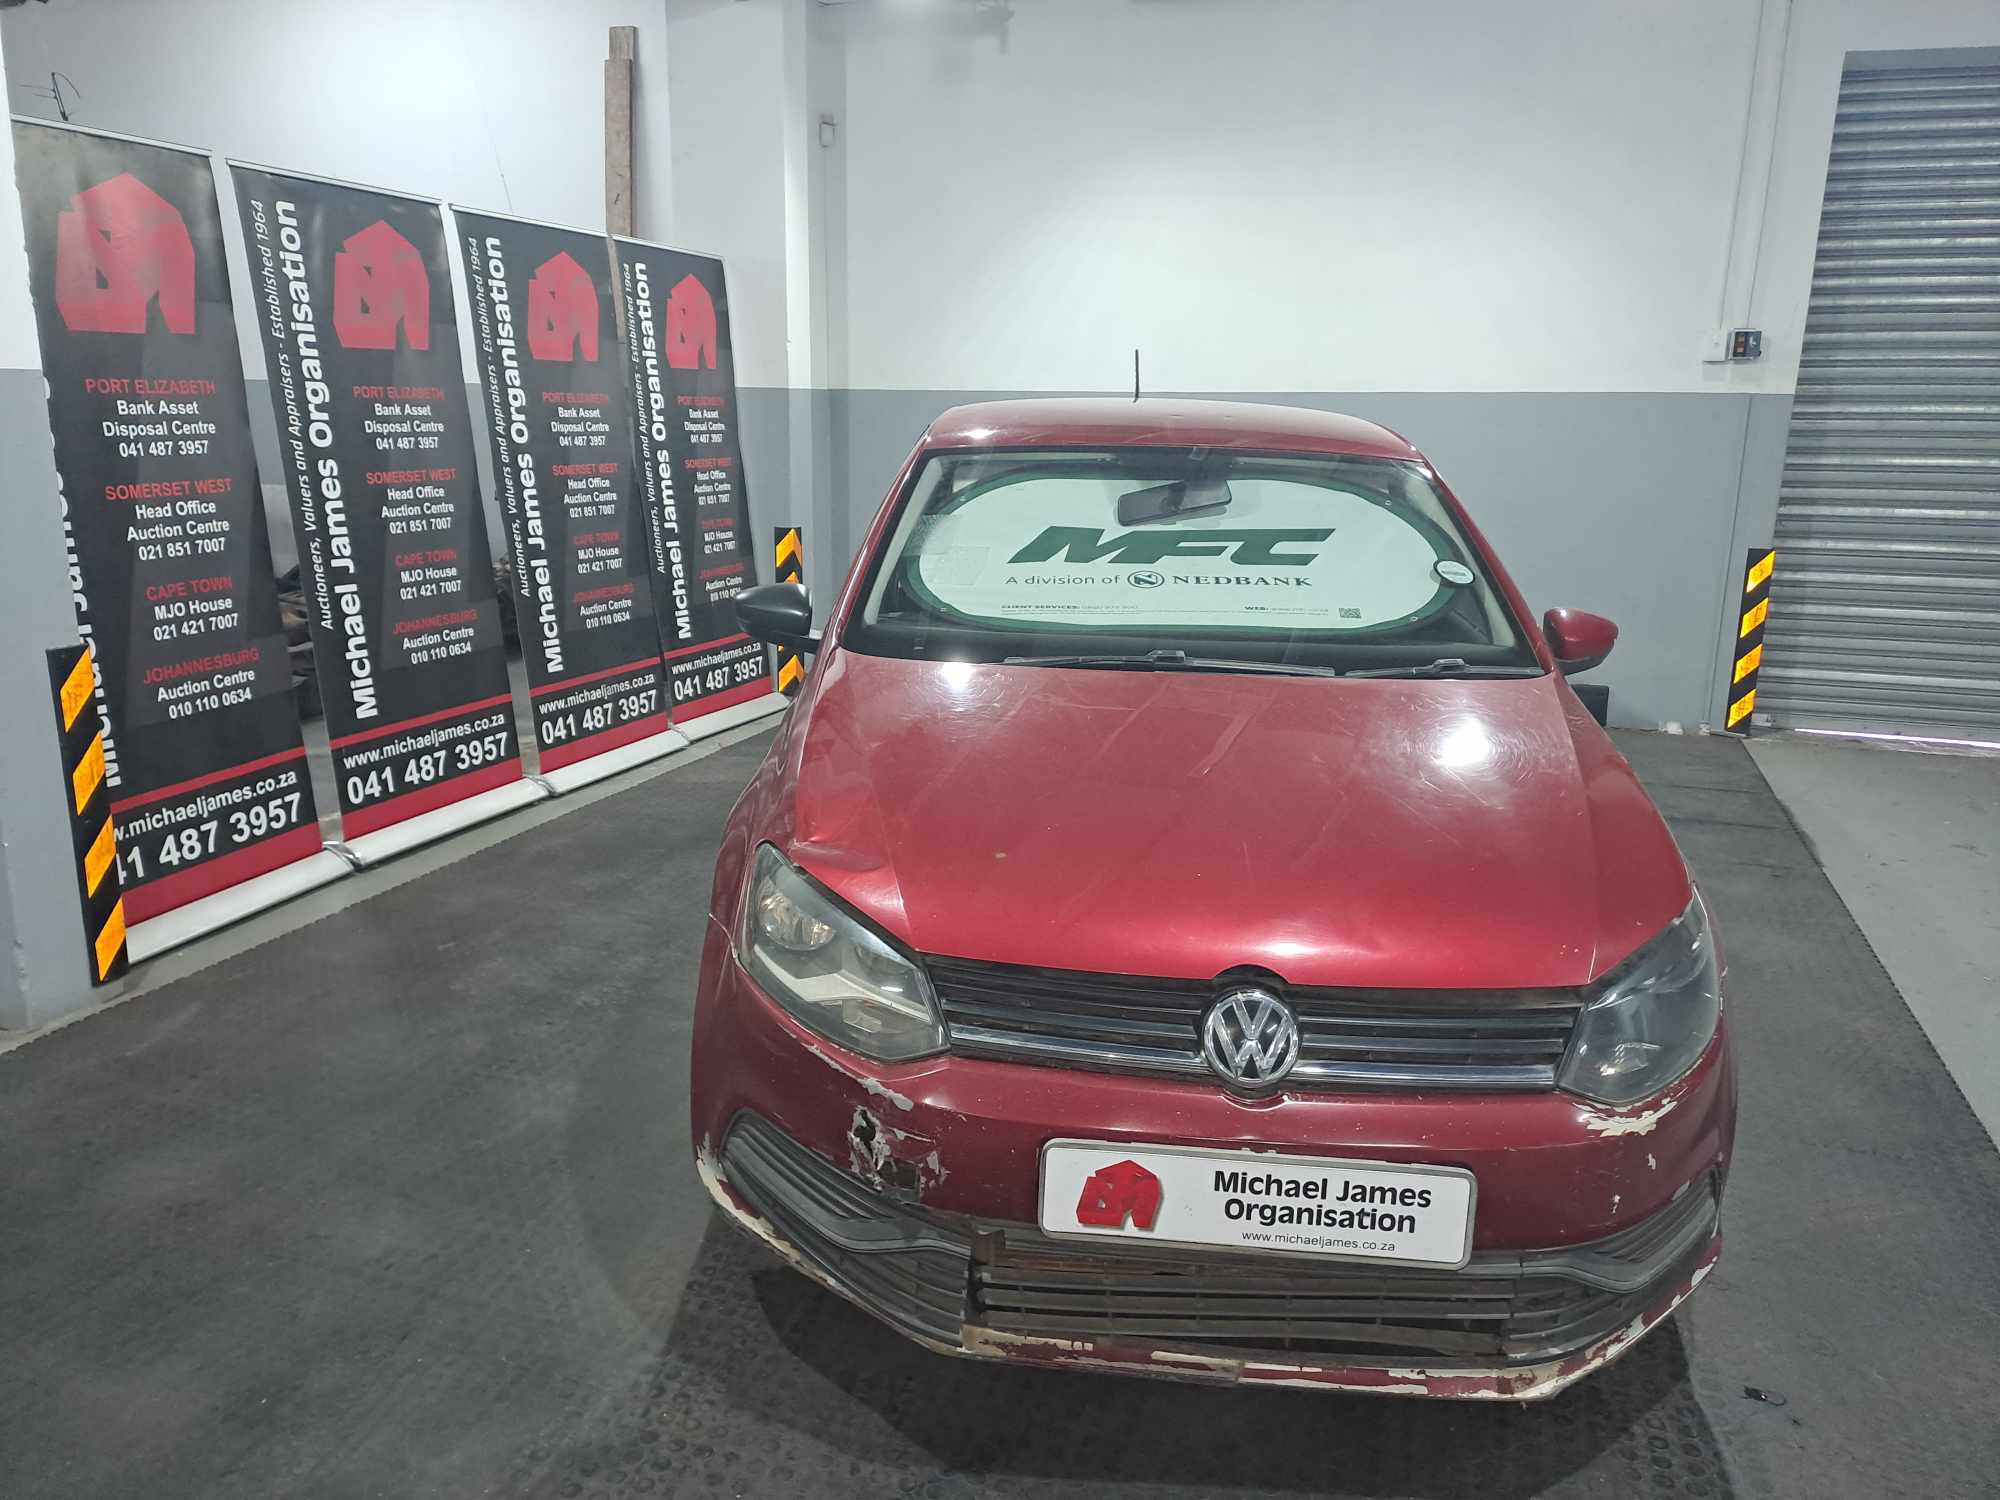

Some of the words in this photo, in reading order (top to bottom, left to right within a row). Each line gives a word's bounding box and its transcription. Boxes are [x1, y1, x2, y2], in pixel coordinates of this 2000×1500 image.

[250, 199, 270, 242] 1964
[468, 237, 482, 270] 1964
[261, 245, 286, 340] Established
[275, 200, 333, 448] Organisation
[475, 273, 493, 353] Established
[486, 237, 529, 444] Organisation
[635, 262, 666, 442] Organisation
[85, 379, 129, 394] PORT
[135, 379, 216, 395] ELIZABETH
[279, 353, 301, 436] Appraisers
[353, 386, 384, 398] PORT
[487, 365, 505, 435] Appraisers
[117, 401, 155, 416] Bank
[159, 400, 199, 415] Asset
[375, 404, 401, 416] Bank
[404, 404, 431, 416] Asset
[558, 407, 577, 418] Bank
[579, 407, 600, 417] Asset
[103, 421, 168, 439] Disposal
[171, 421, 216, 435] Centre
[365, 420, 410, 434] Disposal
[413, 421, 444, 432] Centre
[551, 421, 584, 433] Disposal
[586, 422, 609, 432] Centre
[119, 443, 142, 457] 041
[149, 442, 172, 456] 487
[179, 440, 208, 455] 3957
[291, 439, 307, 470] and
[376, 438, 394, 450] 041
[397, 437, 414, 449] 487
[418, 437, 439, 448] 3957
[496, 437, 509, 463] and
[560, 437, 572, 446] 041
[640, 435, 650, 458] and
[105, 482, 190, 500] SOMERSET
[195, 479, 232, 494] WEST
[366, 471, 427, 484] SOMERSET
[503, 467, 517, 514] Valuers
[568, 480, 586, 489] Head
[588, 478, 610, 488] Office
[644, 461, 657, 502] Valuers
[300, 475, 317, 532] Valuers
[388, 488, 413, 501] Head
[416, 486, 445, 498] Office
[517, 453, 545, 550] James
[564, 494, 591, 504] Auction
[593, 492, 617, 502] Centre
[657, 449, 678, 534] James
[136, 504, 171, 520] Head
[175, 501, 216, 516] Office
[318, 458, 355, 574] James
[381, 505, 421, 518] Auction
[424, 502, 454, 514] Centre
[570, 509, 582, 518] 021
[584, 507, 596, 516] 851
[127, 524, 182, 542] Auction
[186, 520, 229, 535] Centre
[390, 522, 406, 534] 021
[409, 520, 427, 532] 851
[430, 517, 451, 529] 7007
[139, 545, 162, 561] 021
[167, 541, 191, 557] 851
[195, 537, 226, 553] 7007
[512, 519, 530, 597] Auctioneers,
[578, 548, 594, 560] MJO
[595, 547, 619, 557] House
[1007, 525, 1336, 566] MFC
[401, 569, 423, 583] MJO
[426, 567, 457, 580] House
[578, 564, 590, 574] 021
[592, 561, 604, 571] 421
[1005, 576, 1017, 584] A
[1025, 574, 1095, 585] division
[1102, 573, 1120, 584] of
[1172, 575, 1313, 587] NEDBANK
[146, 582, 185, 600] CAPE
[191, 576, 233, 594] TOWN
[309, 537, 333, 630] Auctioneers,
[401, 587, 417, 600] 021
[420, 584, 437, 597] 421
[441, 581, 461, 594] 7007
[666, 541, 692, 639] Michael
[154, 602, 185, 621] MJO
[189, 598, 233, 615] House
[530, 559, 564, 673] Michael
[580, 604, 607, 616] Auction
[609, 599, 632, 610] Centre
[600, 615, 612, 626] 110
[154, 623, 177, 641] 021
[181, 619, 205, 636] 421
[209, 614, 238, 632] 7007
[403, 634, 440, 650] Auction
[443, 627, 474, 641] Centre
[335, 583, 379, 719] Michael
[411, 652, 428, 664] 010
[430, 647, 446, 660] 110
[449, 642, 471, 657] 0634
[672, 642, 761, 674] www.michaeljames.co.za
[143, 648, 259, 684] JOHANNESBURG
[674, 675, 700, 700] 041
[706, 667, 729, 690] 487
[735, 656, 763, 682] 3957
[157, 679, 210, 702] Auction
[214, 669, 255, 689] Centre
[539, 673, 655, 715] www.michaeljames.co.za
[169, 701, 192, 720] 010
[195, 696, 219, 713] 110
[222, 689, 251, 707] 0634
[541, 714, 575, 744] 041
[583, 702, 613, 731] 487
[619, 690, 657, 720] 3957
[343, 713, 504, 769] www.michaeljames.co.za
[347, 766, 394, 804] 041
[404, 750, 446, 785] 487
[455, 733, 508, 769] 3957
[114, 772, 297, 841] w.michaeljames.co.za
[159, 821, 218, 866] 487
[229, 793, 300, 843] 3957
[1213, 1170, 1327, 1200] Michael
[1336, 1179, 1432, 1208] James
[1224, 1199, 1416, 1233] Organisation
[1242, 1230, 1396, 1252] www.michaeljames.co.za
